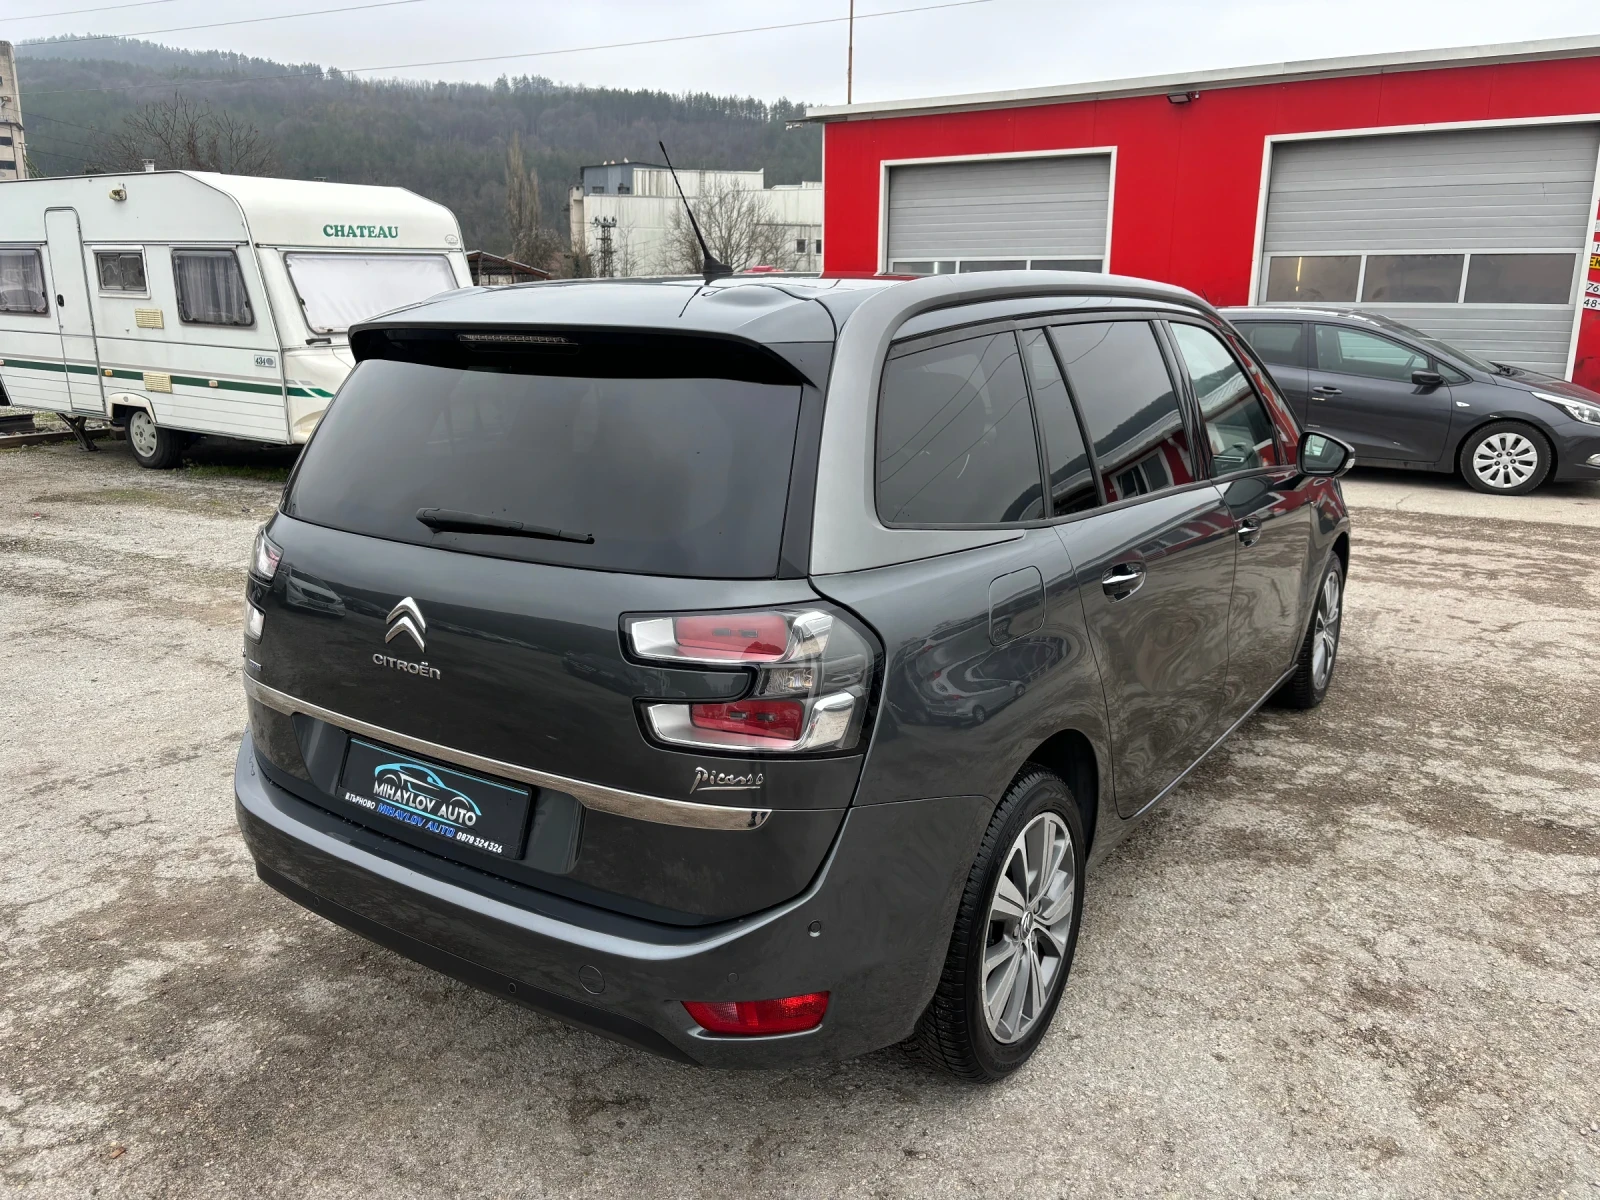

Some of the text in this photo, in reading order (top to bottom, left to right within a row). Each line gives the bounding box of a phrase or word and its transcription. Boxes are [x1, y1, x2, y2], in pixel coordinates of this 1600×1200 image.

[322, 224, 399, 239] CHATEAU
[689, 766, 764, 794] Picasso
[373, 780, 477, 826] MIHAYLOV AUTO
[377, 803, 427, 827] MIHAYLOV
[426, 821, 456, 838] AUTO
